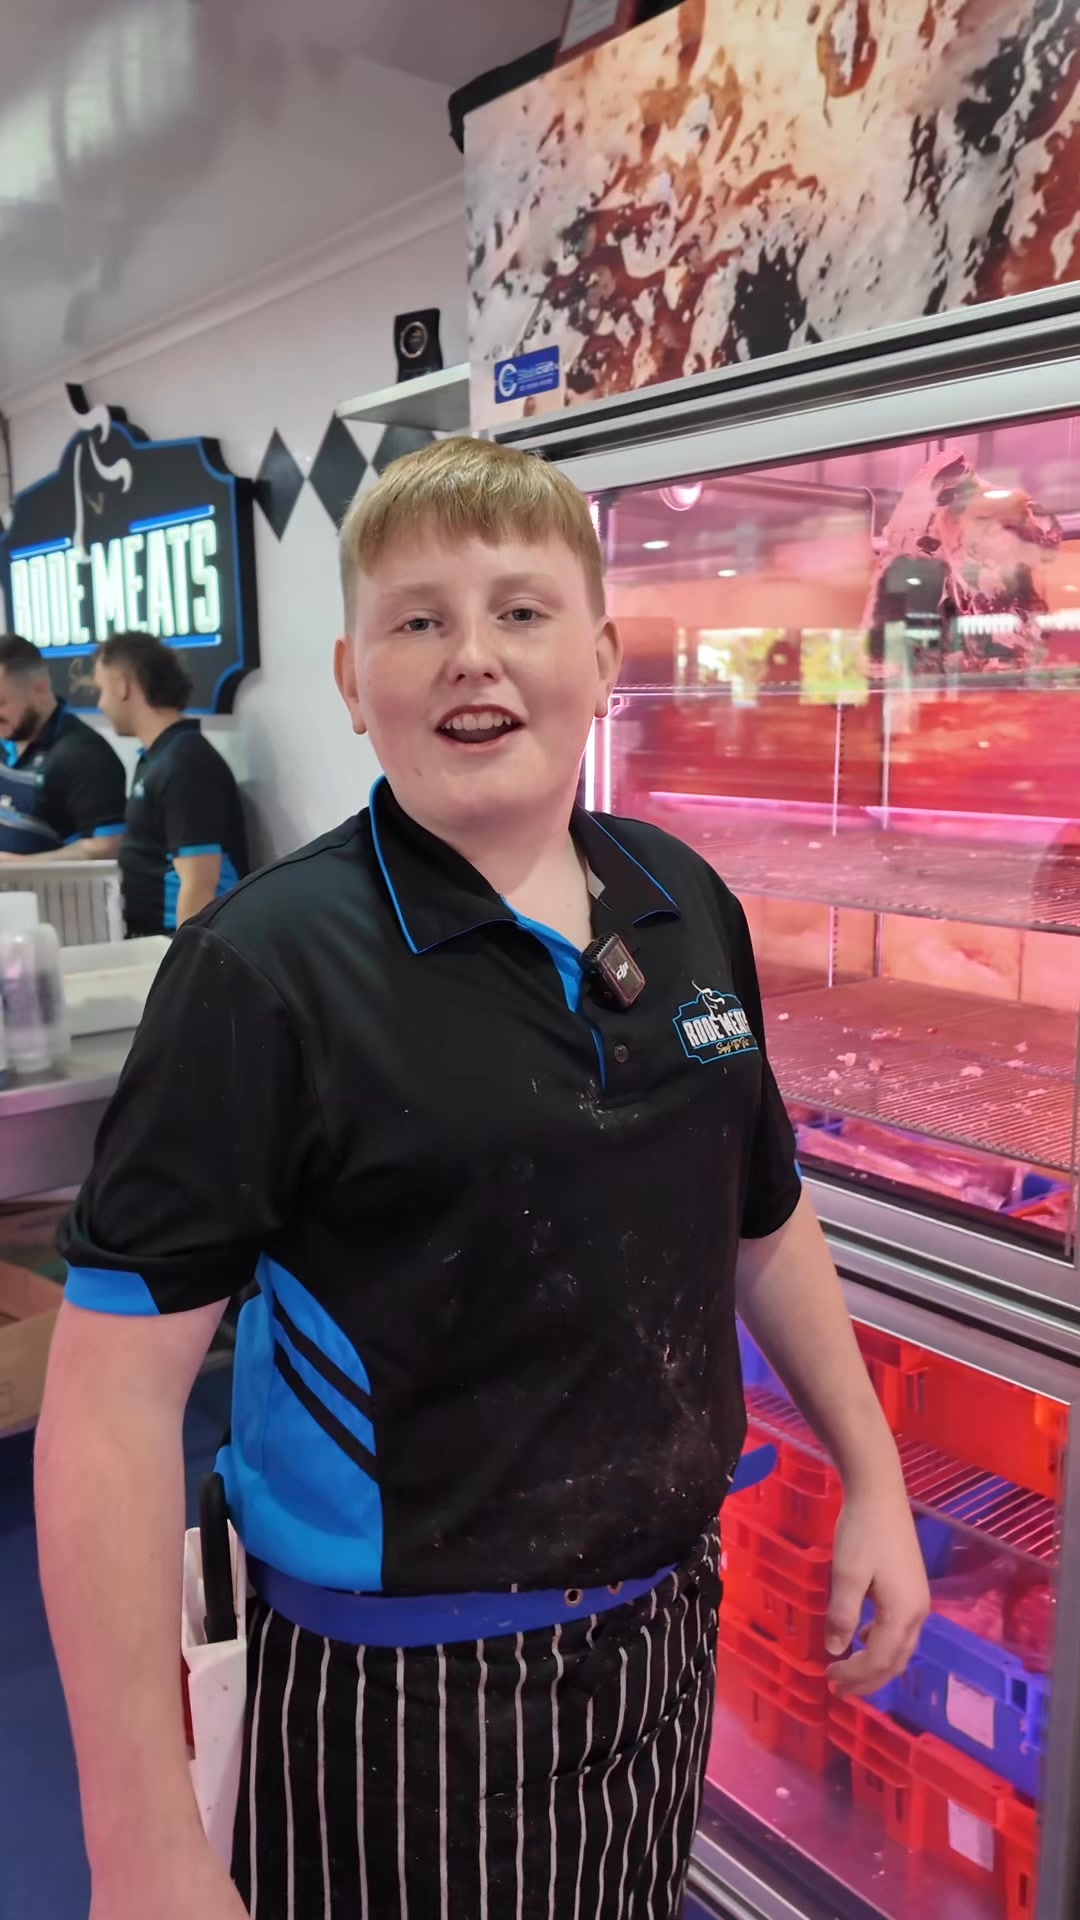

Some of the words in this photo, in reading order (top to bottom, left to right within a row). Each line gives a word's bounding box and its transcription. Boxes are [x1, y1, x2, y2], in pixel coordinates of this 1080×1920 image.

[10, 548, 90, 648] RODE
[91, 518, 221, 643] MEATS
[682, 1016, 725, 1047] RODE
